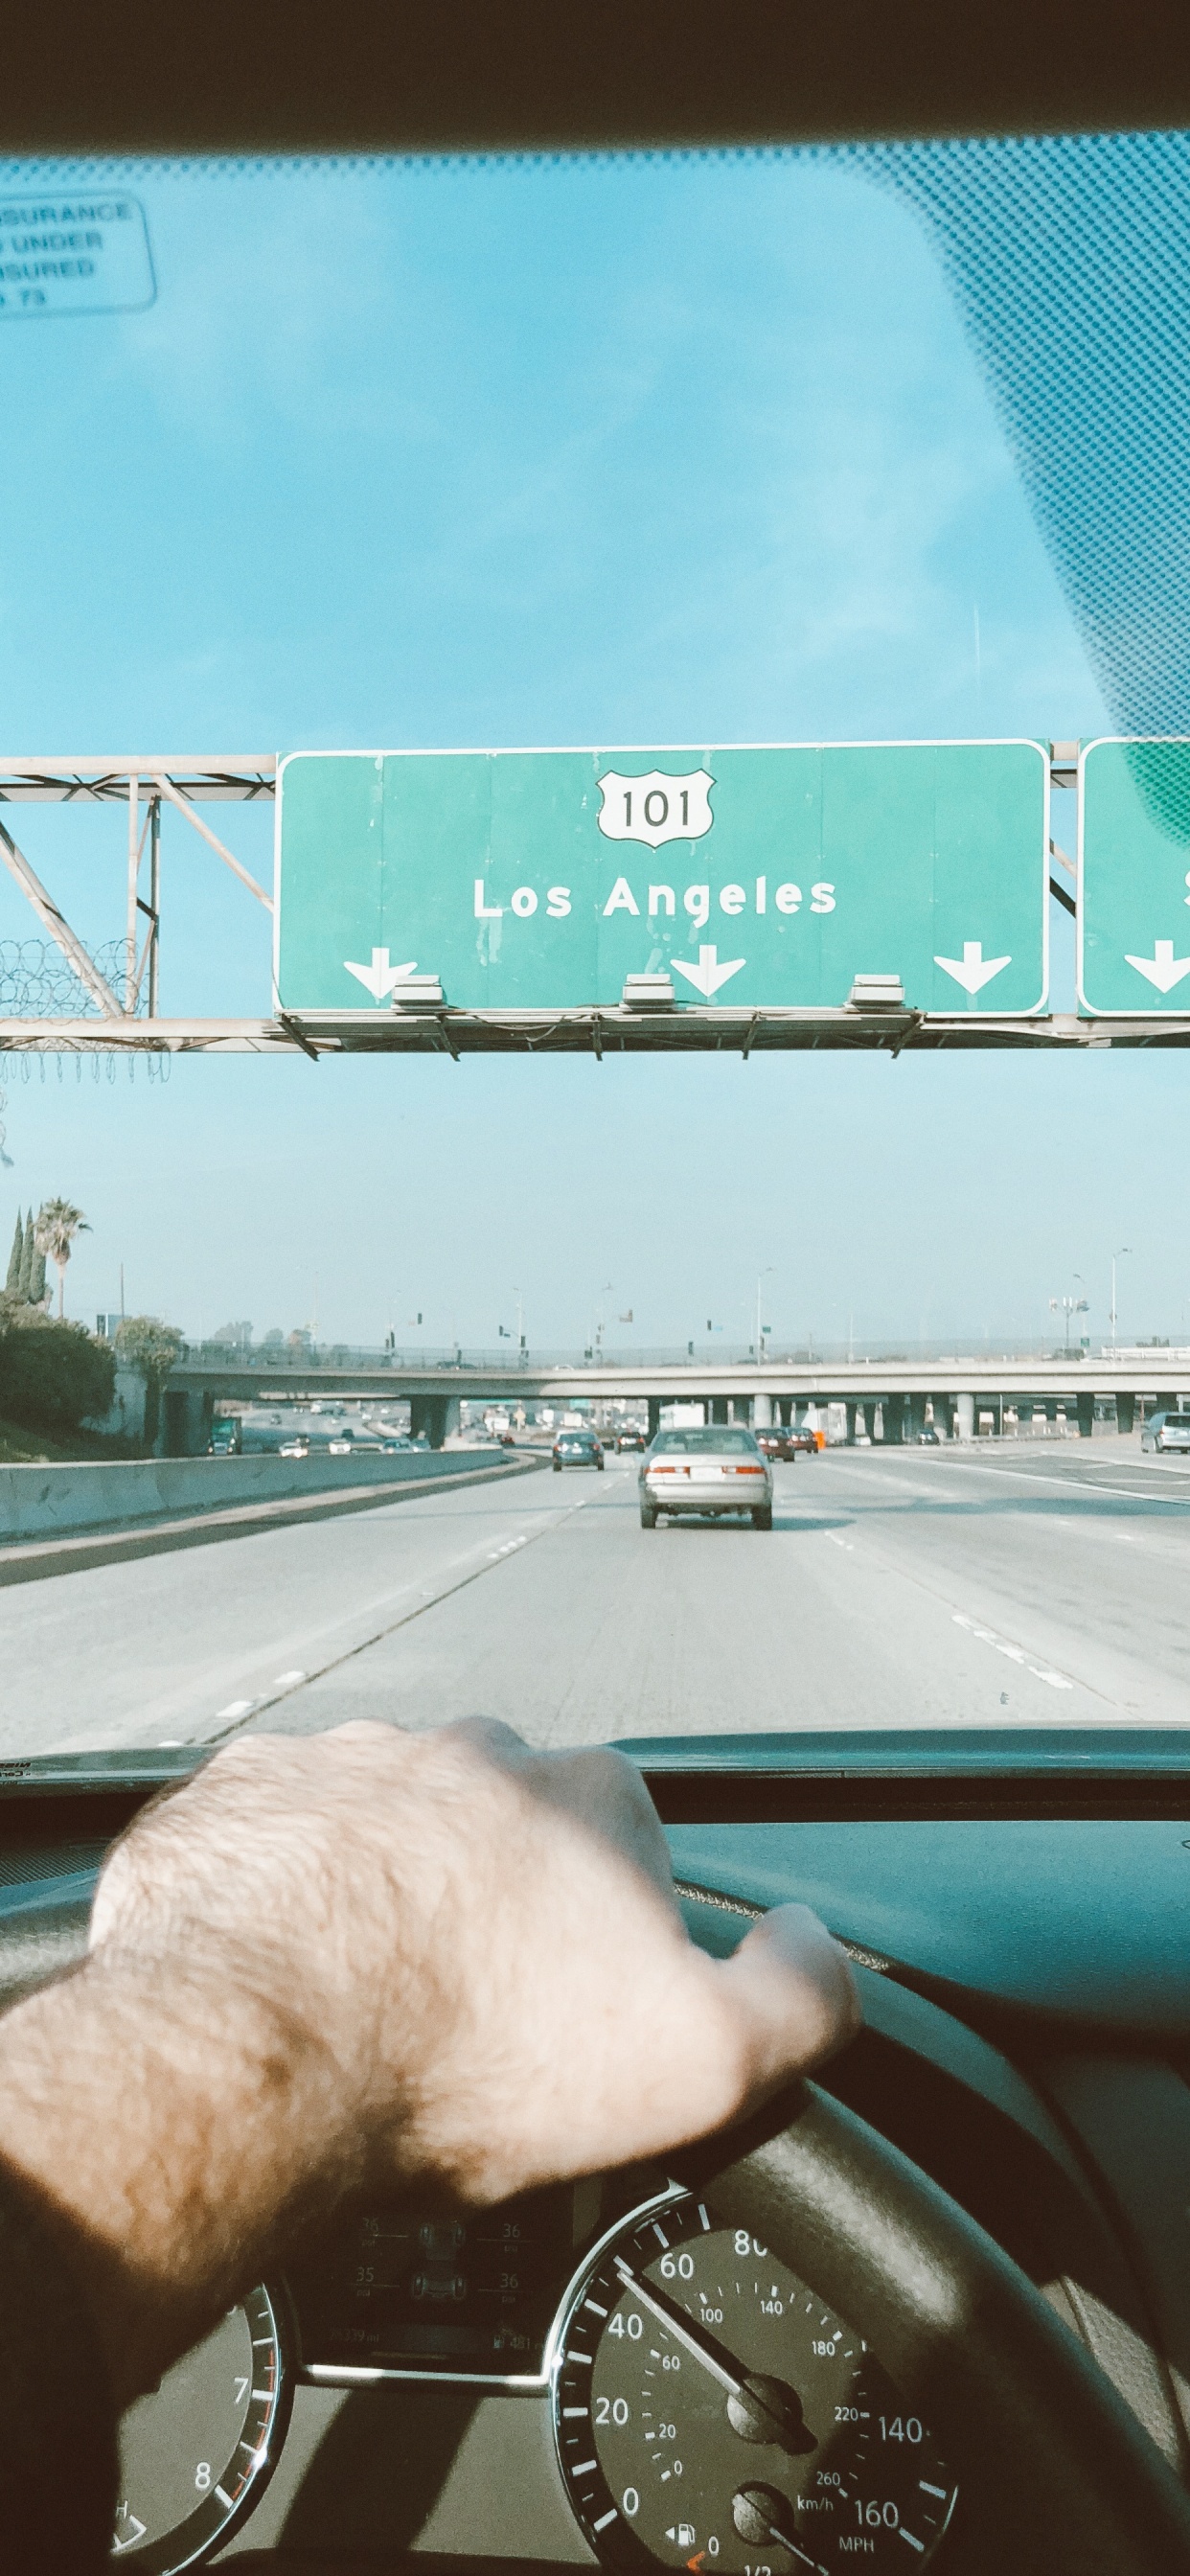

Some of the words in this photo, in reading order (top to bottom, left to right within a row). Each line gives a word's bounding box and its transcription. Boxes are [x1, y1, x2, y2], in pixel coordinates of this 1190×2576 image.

[0, 204, 131, 225] SURANCE
[11, 231, 103, 251] UNDER
[623, 790, 689, 827] 101
[474, 879, 572, 917] Los
[603, 876, 836, 928] Angeles
[503, 2222, 521, 2239] 36
[355, 2266, 375, 2283] 35
[660, 2252, 694, 2279] 60
[499, 2272, 519, 2288] 36
[700, 2308, 723, 2324] 100
[760, 2300, 783, 2315] 140
[608, 2312, 643, 2340] 40
[812, 2339, 835, 2357] 180
[662, 2355, 680, 2371] 60
[234, 2377, 249, 2404] 7
[596, 2397, 629, 2426] 20
[834, 2406, 858, 2422] 220
[658, 2424, 676, 2439] 20
[879, 2416, 922, 2444] 140
[195, 2462, 211, 2490] 8
[674, 2460, 683, 2475] 0
[816, 2471, 840, 2486] 260
[622, 2487, 639, 2515] 0
[797, 2495, 834, 2512] km/h
[854, 2499, 900, 2528] 160
[708, 2536, 720, 2556] 0
[838, 2536, 875, 2553] MPH
